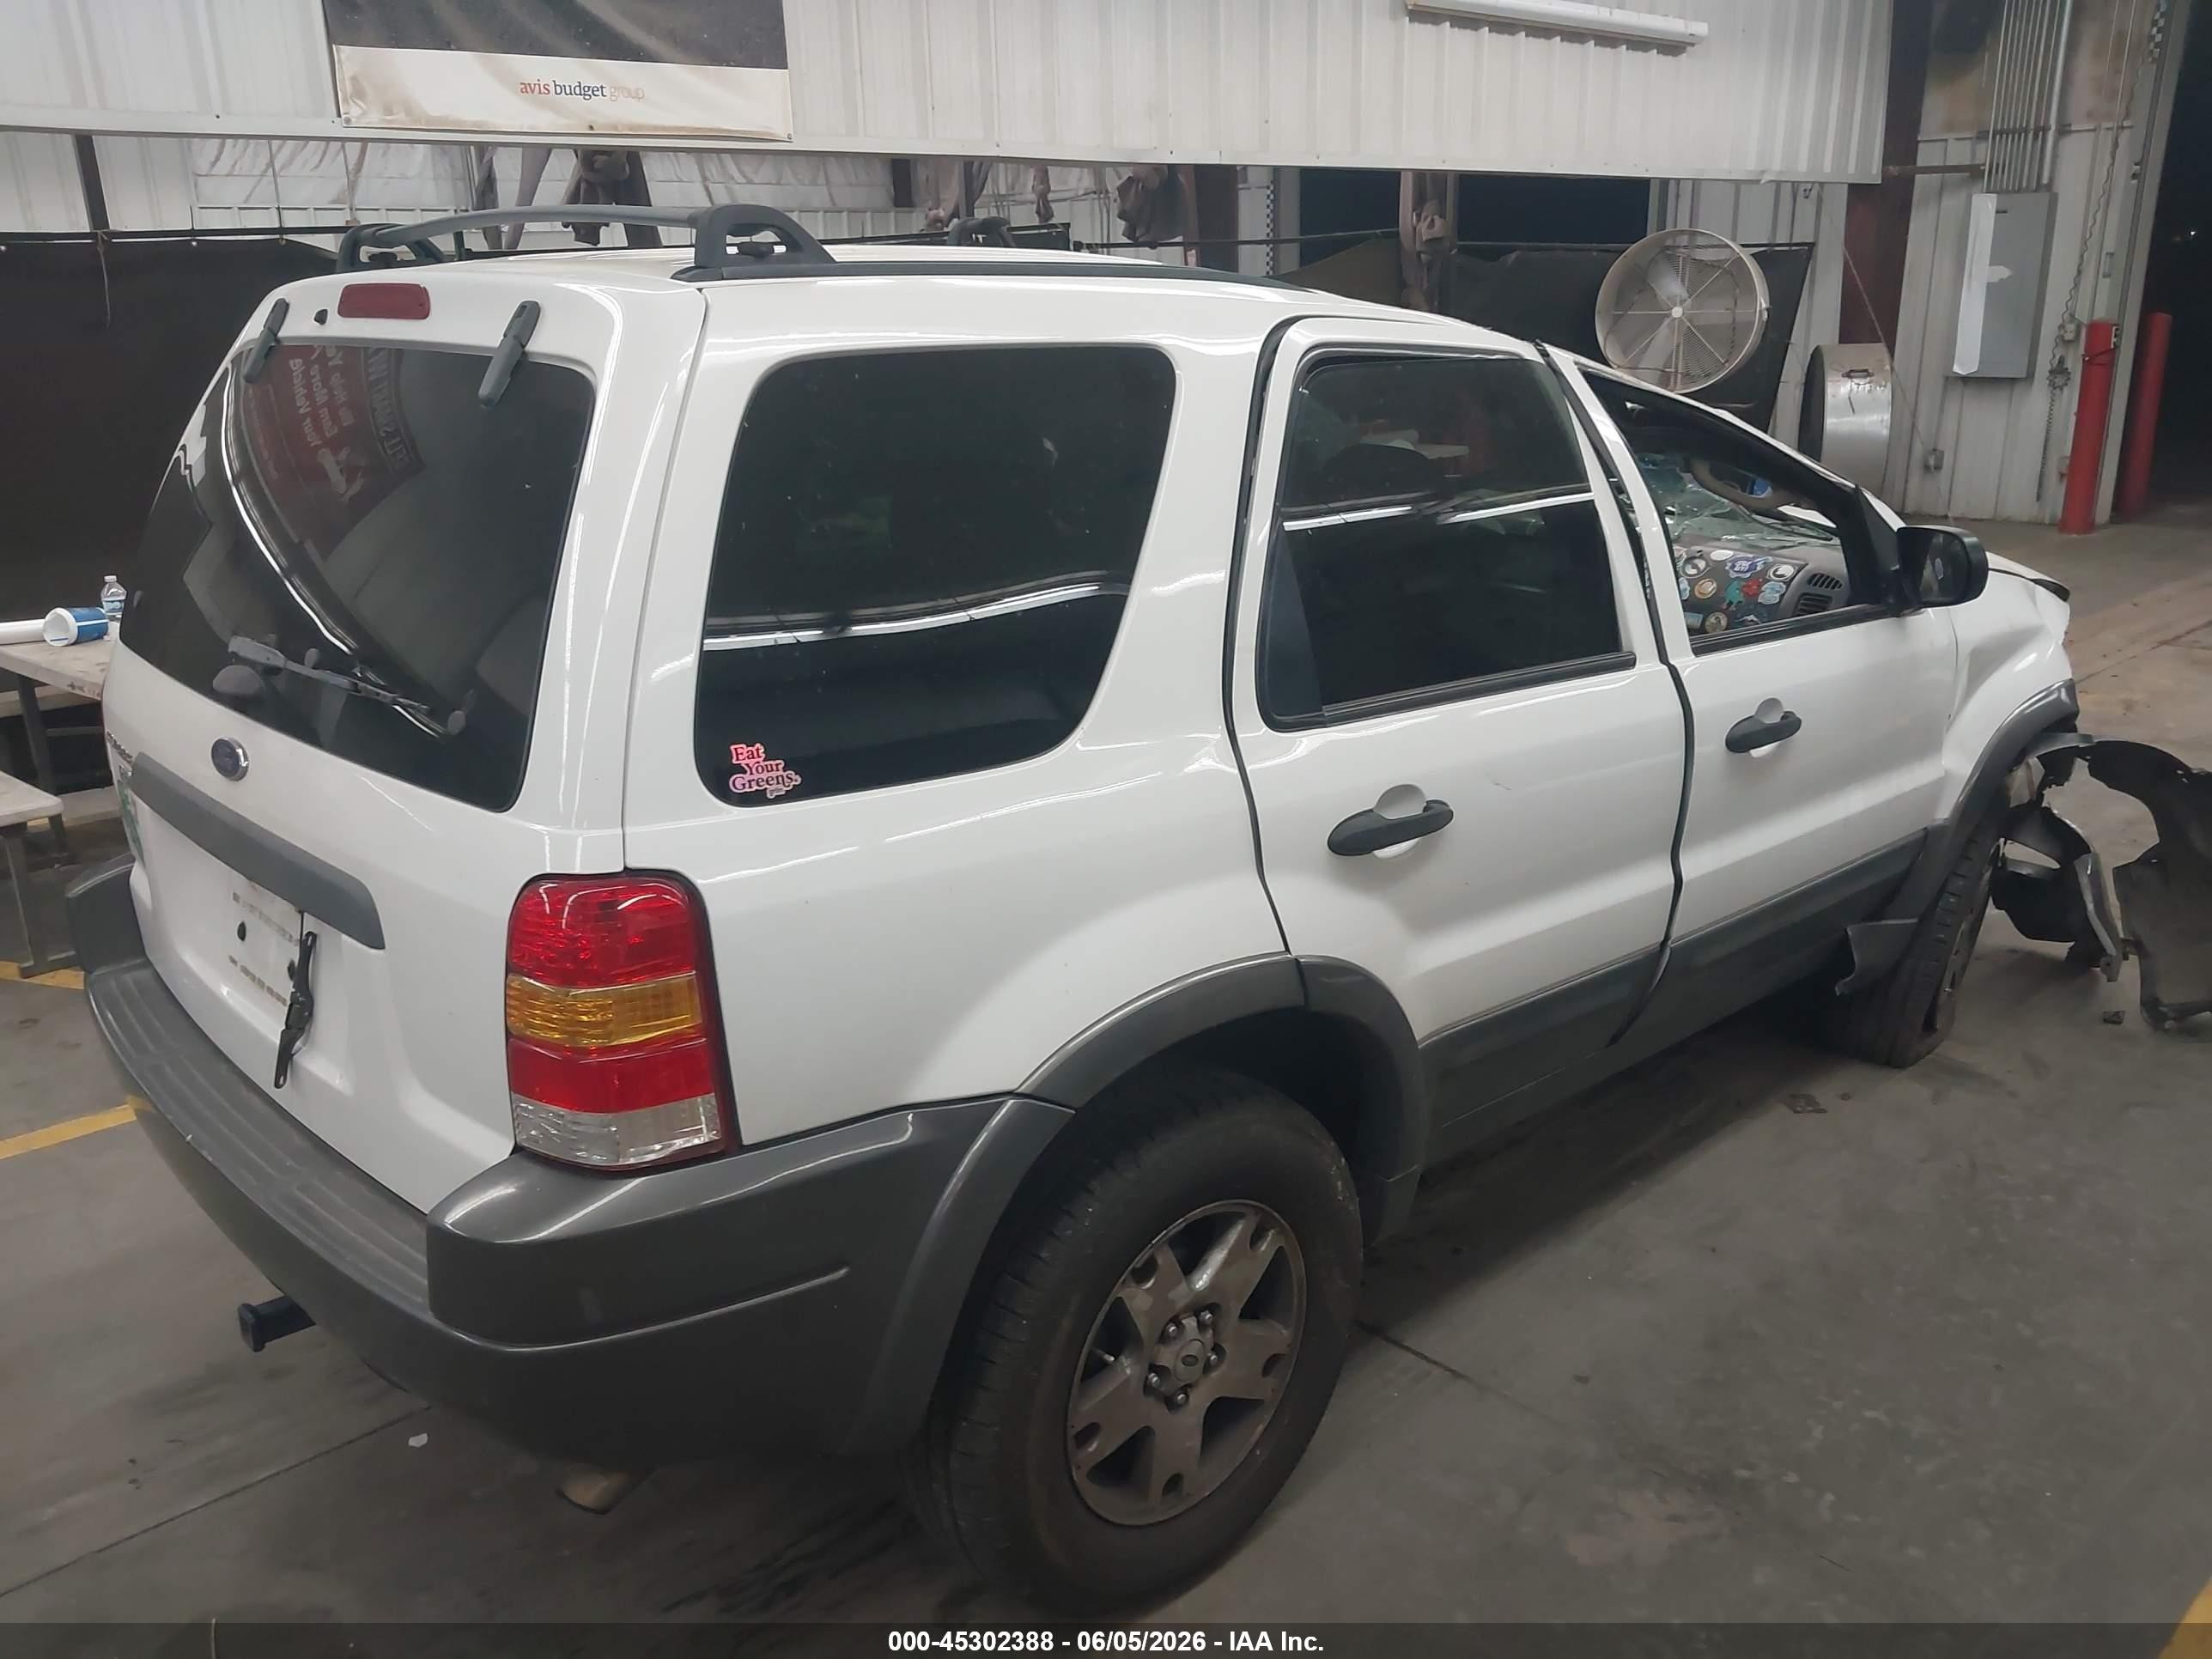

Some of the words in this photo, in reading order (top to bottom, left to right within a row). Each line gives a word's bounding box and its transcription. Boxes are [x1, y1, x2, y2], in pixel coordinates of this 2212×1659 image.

[520, 78, 550, 95] avis
[552, 80, 607, 100] budget
[610, 86, 645, 102] group
[733, 746, 762, 762] Eat
[744, 762, 782, 775] Your
[732, 773, 798, 791] Greens.
